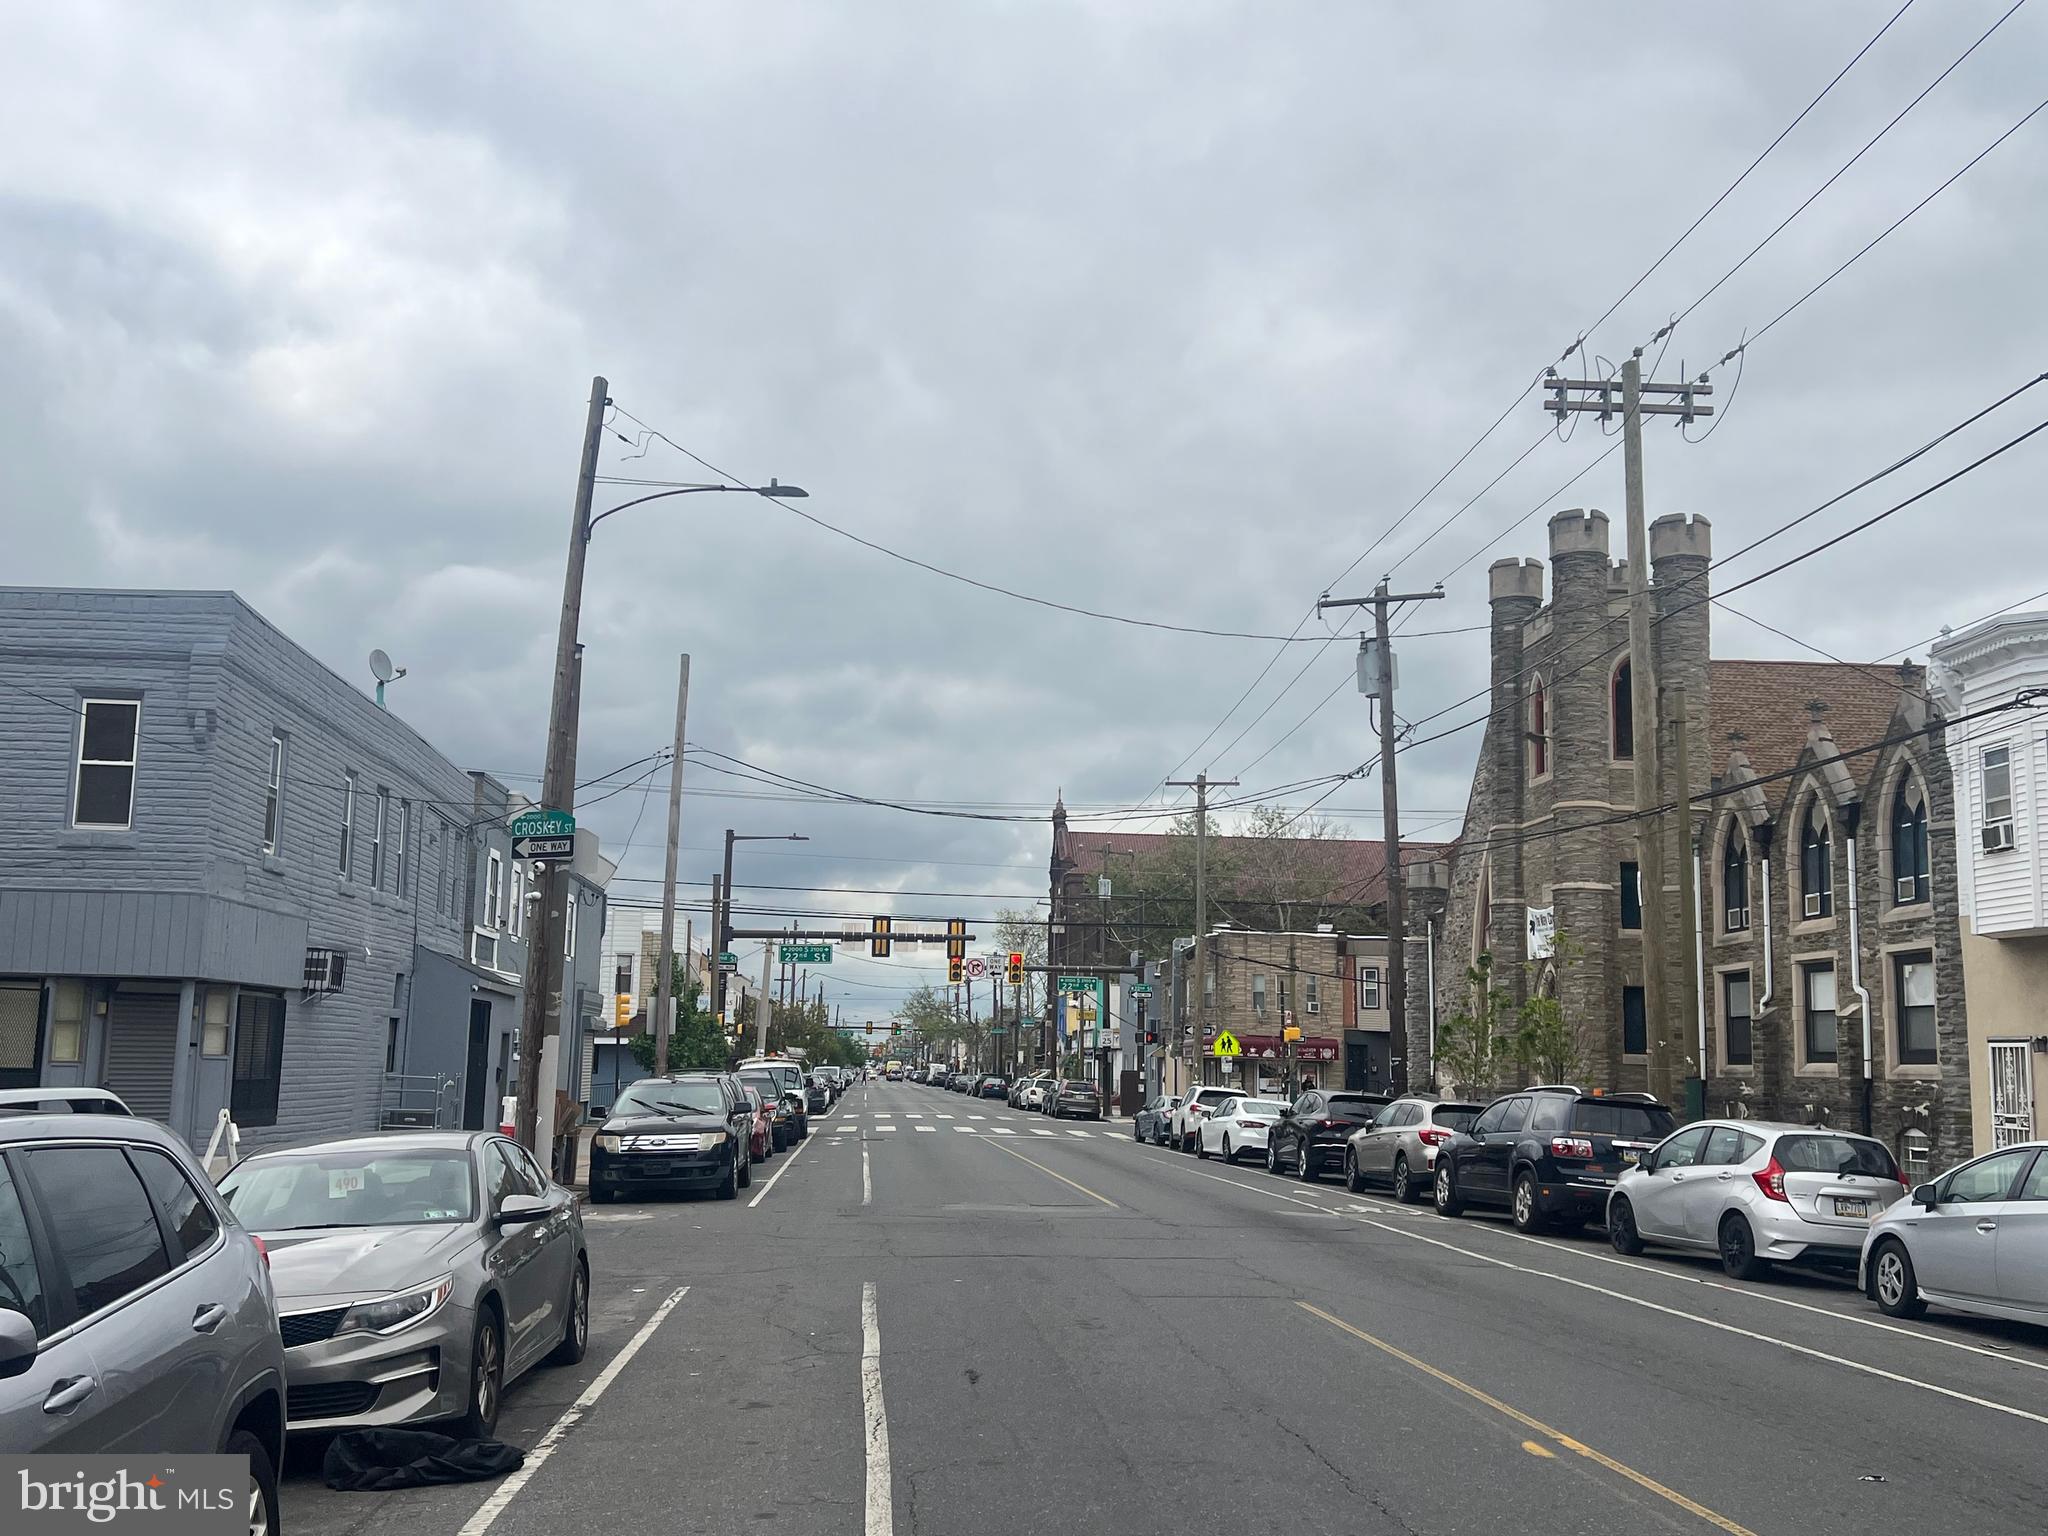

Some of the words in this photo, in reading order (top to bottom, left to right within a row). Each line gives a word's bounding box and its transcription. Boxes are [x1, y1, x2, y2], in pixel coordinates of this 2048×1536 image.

[515, 821, 561, 835] CROSKEY
[565, 824, 572, 832] ST
[530, 843, 547, 851] ONE
[551, 842, 568, 850] WAY
[785, 953, 807, 961] 22nd
[814, 953, 826, 961] St
[335, 1176, 358, 1190] 490
